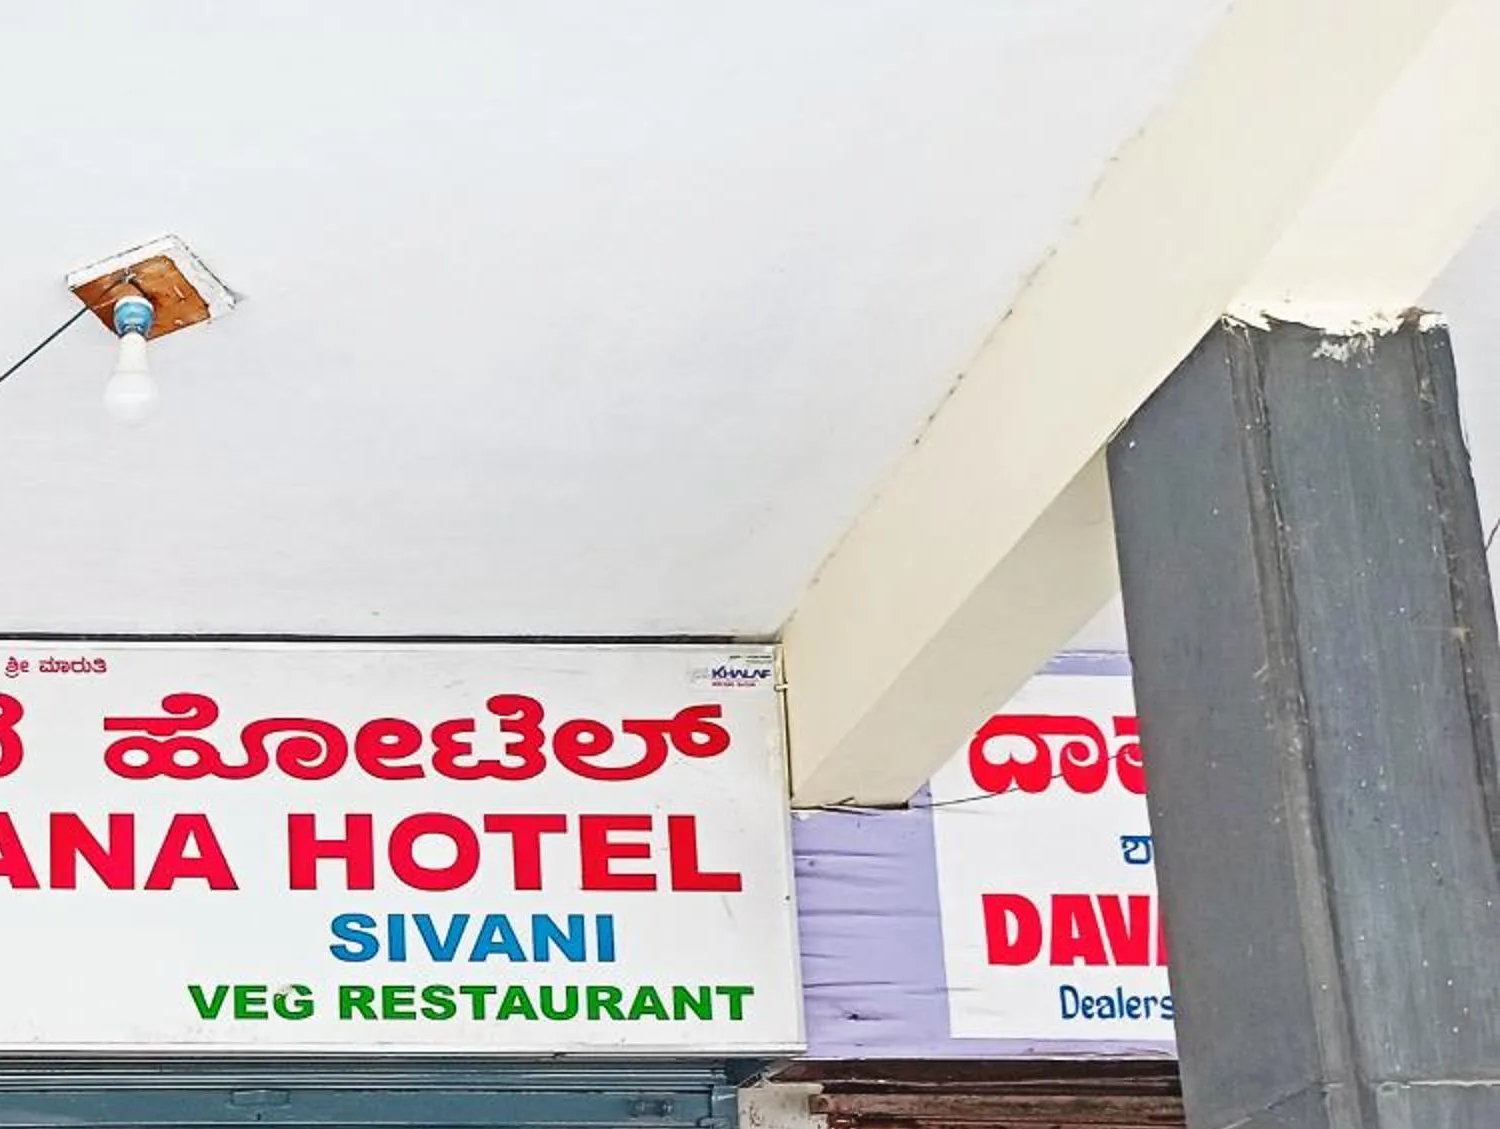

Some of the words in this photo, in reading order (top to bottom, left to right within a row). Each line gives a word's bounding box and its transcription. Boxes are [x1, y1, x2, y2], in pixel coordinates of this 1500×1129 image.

[38, 656, 107, 673] ಮಾರುತಿ
[103, 692, 731, 781] ಹೋಟೆಲ್
[288, 812, 743, 893] HOTEL
[330, 912, 617, 964] SIVANI
[188, 983, 316, 1021] VEG
[338, 984, 754, 1022] RESTAURANT
